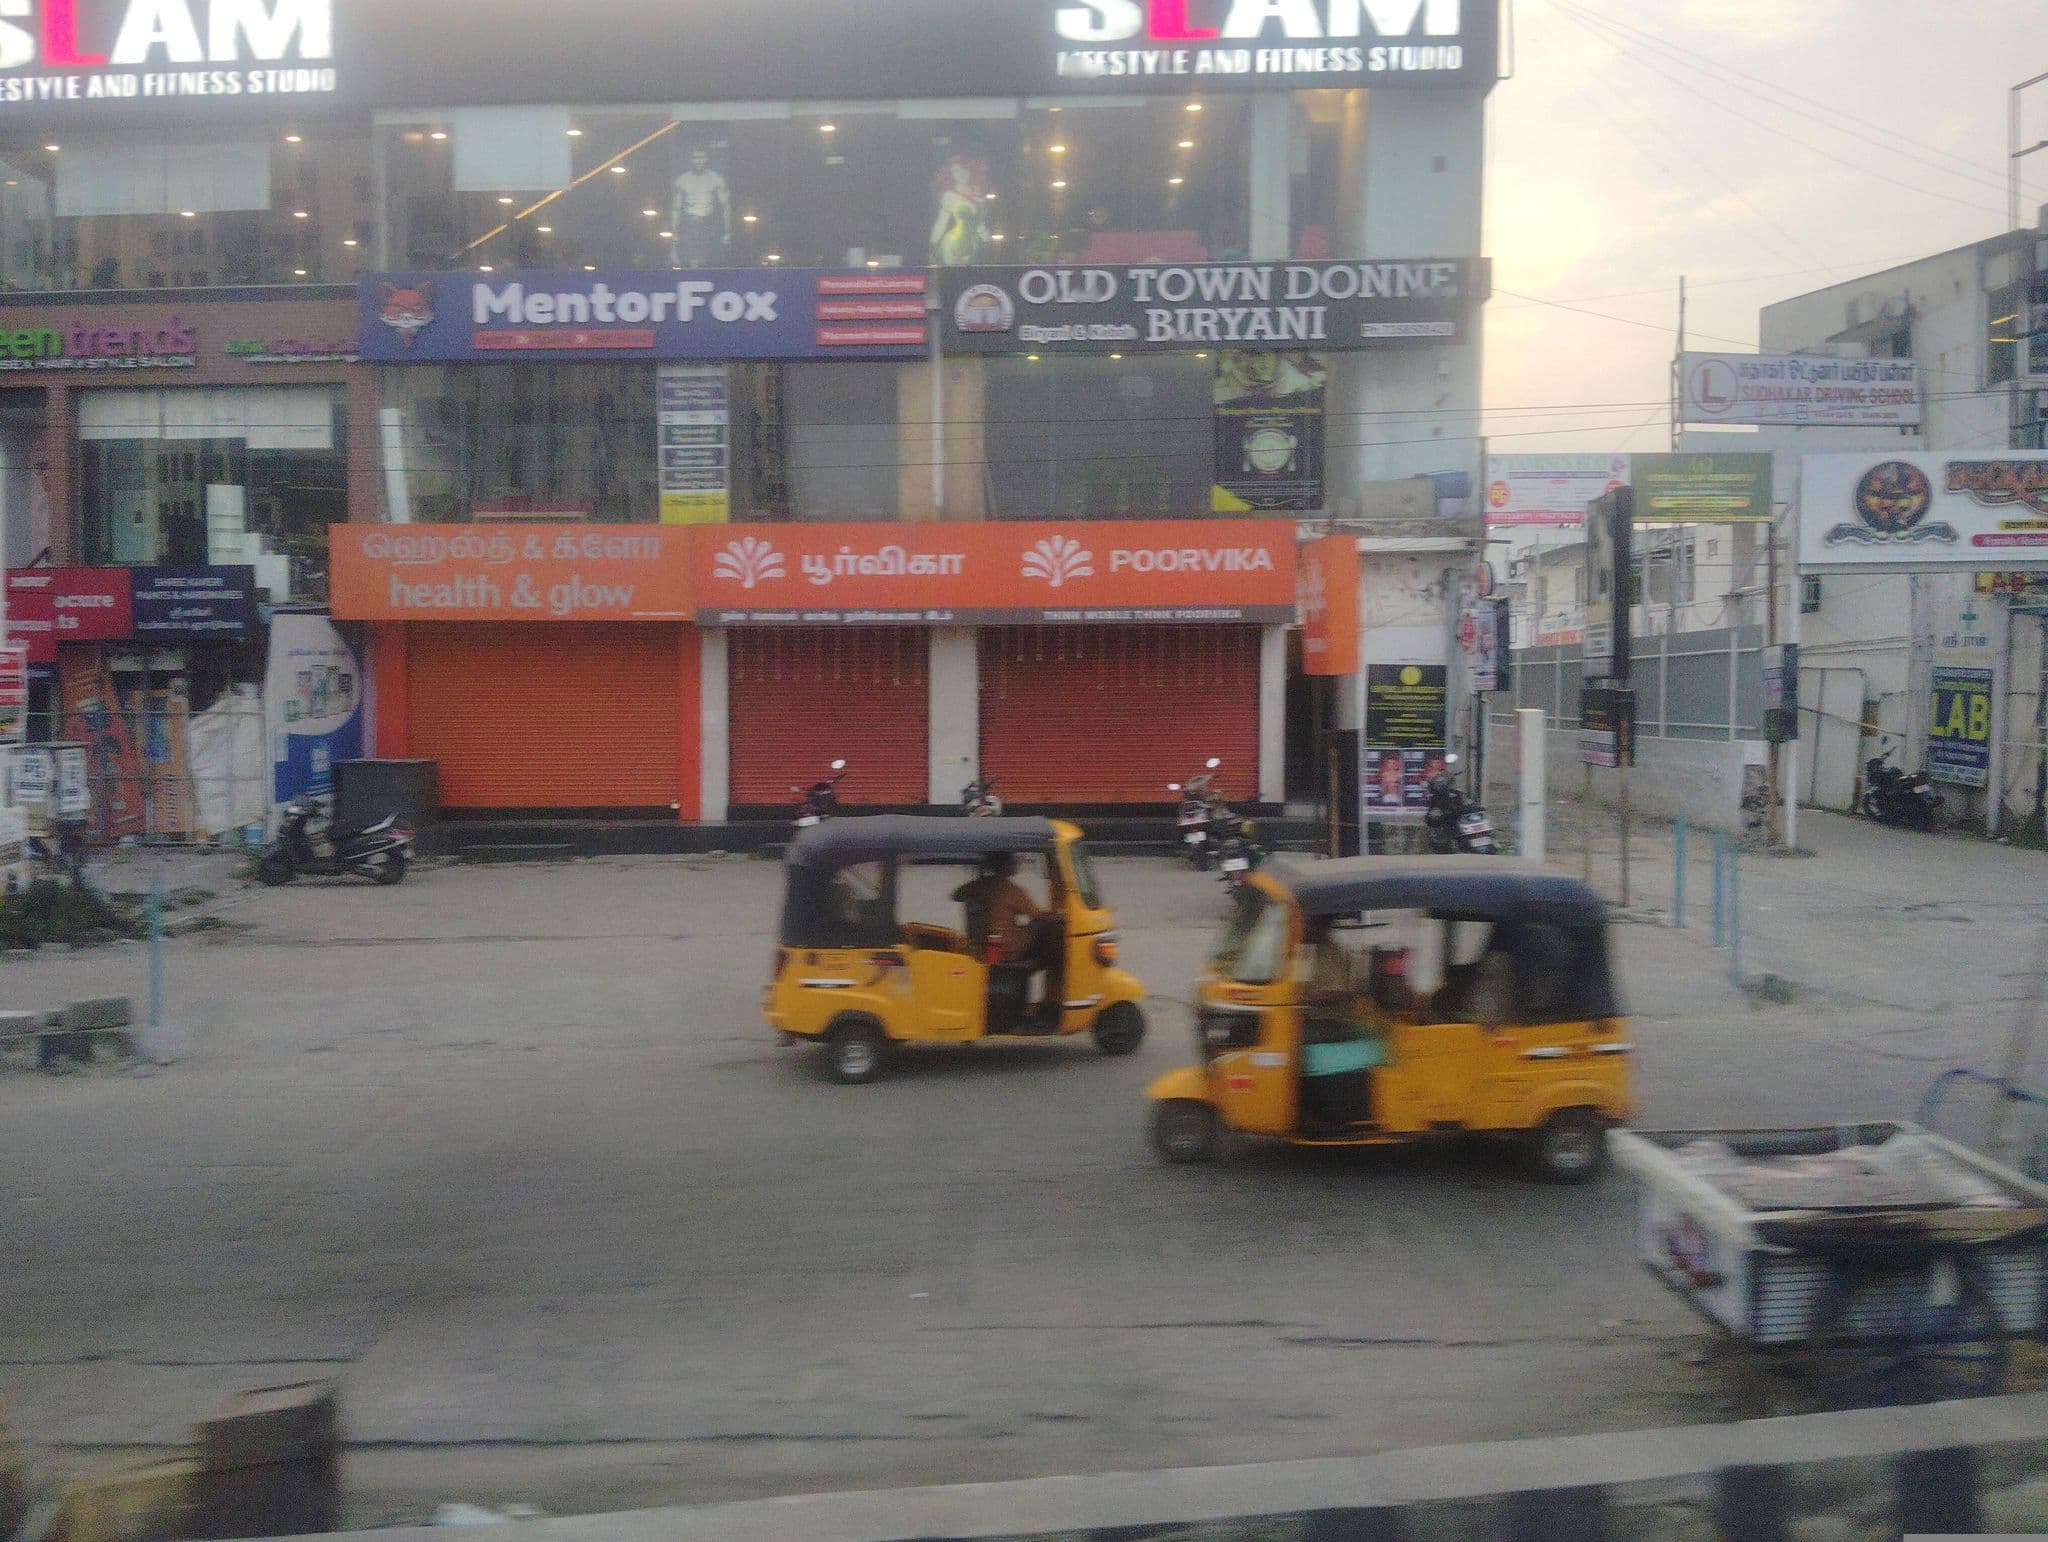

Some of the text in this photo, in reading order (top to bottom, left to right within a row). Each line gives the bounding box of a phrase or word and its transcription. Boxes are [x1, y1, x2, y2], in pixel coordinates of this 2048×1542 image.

[1057, 46, 1462, 77] LESTYLE AND FITNESS STUDIO
[87, 74, 137, 97] AND
[144, 71, 241, 96] FITNESS
[249, 68, 335, 93] STUDIO
[1018, 263, 1458, 304] OLD TOWN DONNE
[472, 281, 777, 323] MentorFox
[1144, 306, 1328, 341] BIRYANI
[1815, 387, 1866, 403] DRIVING
[521, 533, 547, 560] &
[1109, 548, 1275, 573] POORVIKA
[801, 545, 966, 586] பூர்விகா
[389, 570, 635, 617] health & glow
[1928, 692, 1989, 741] LAB
